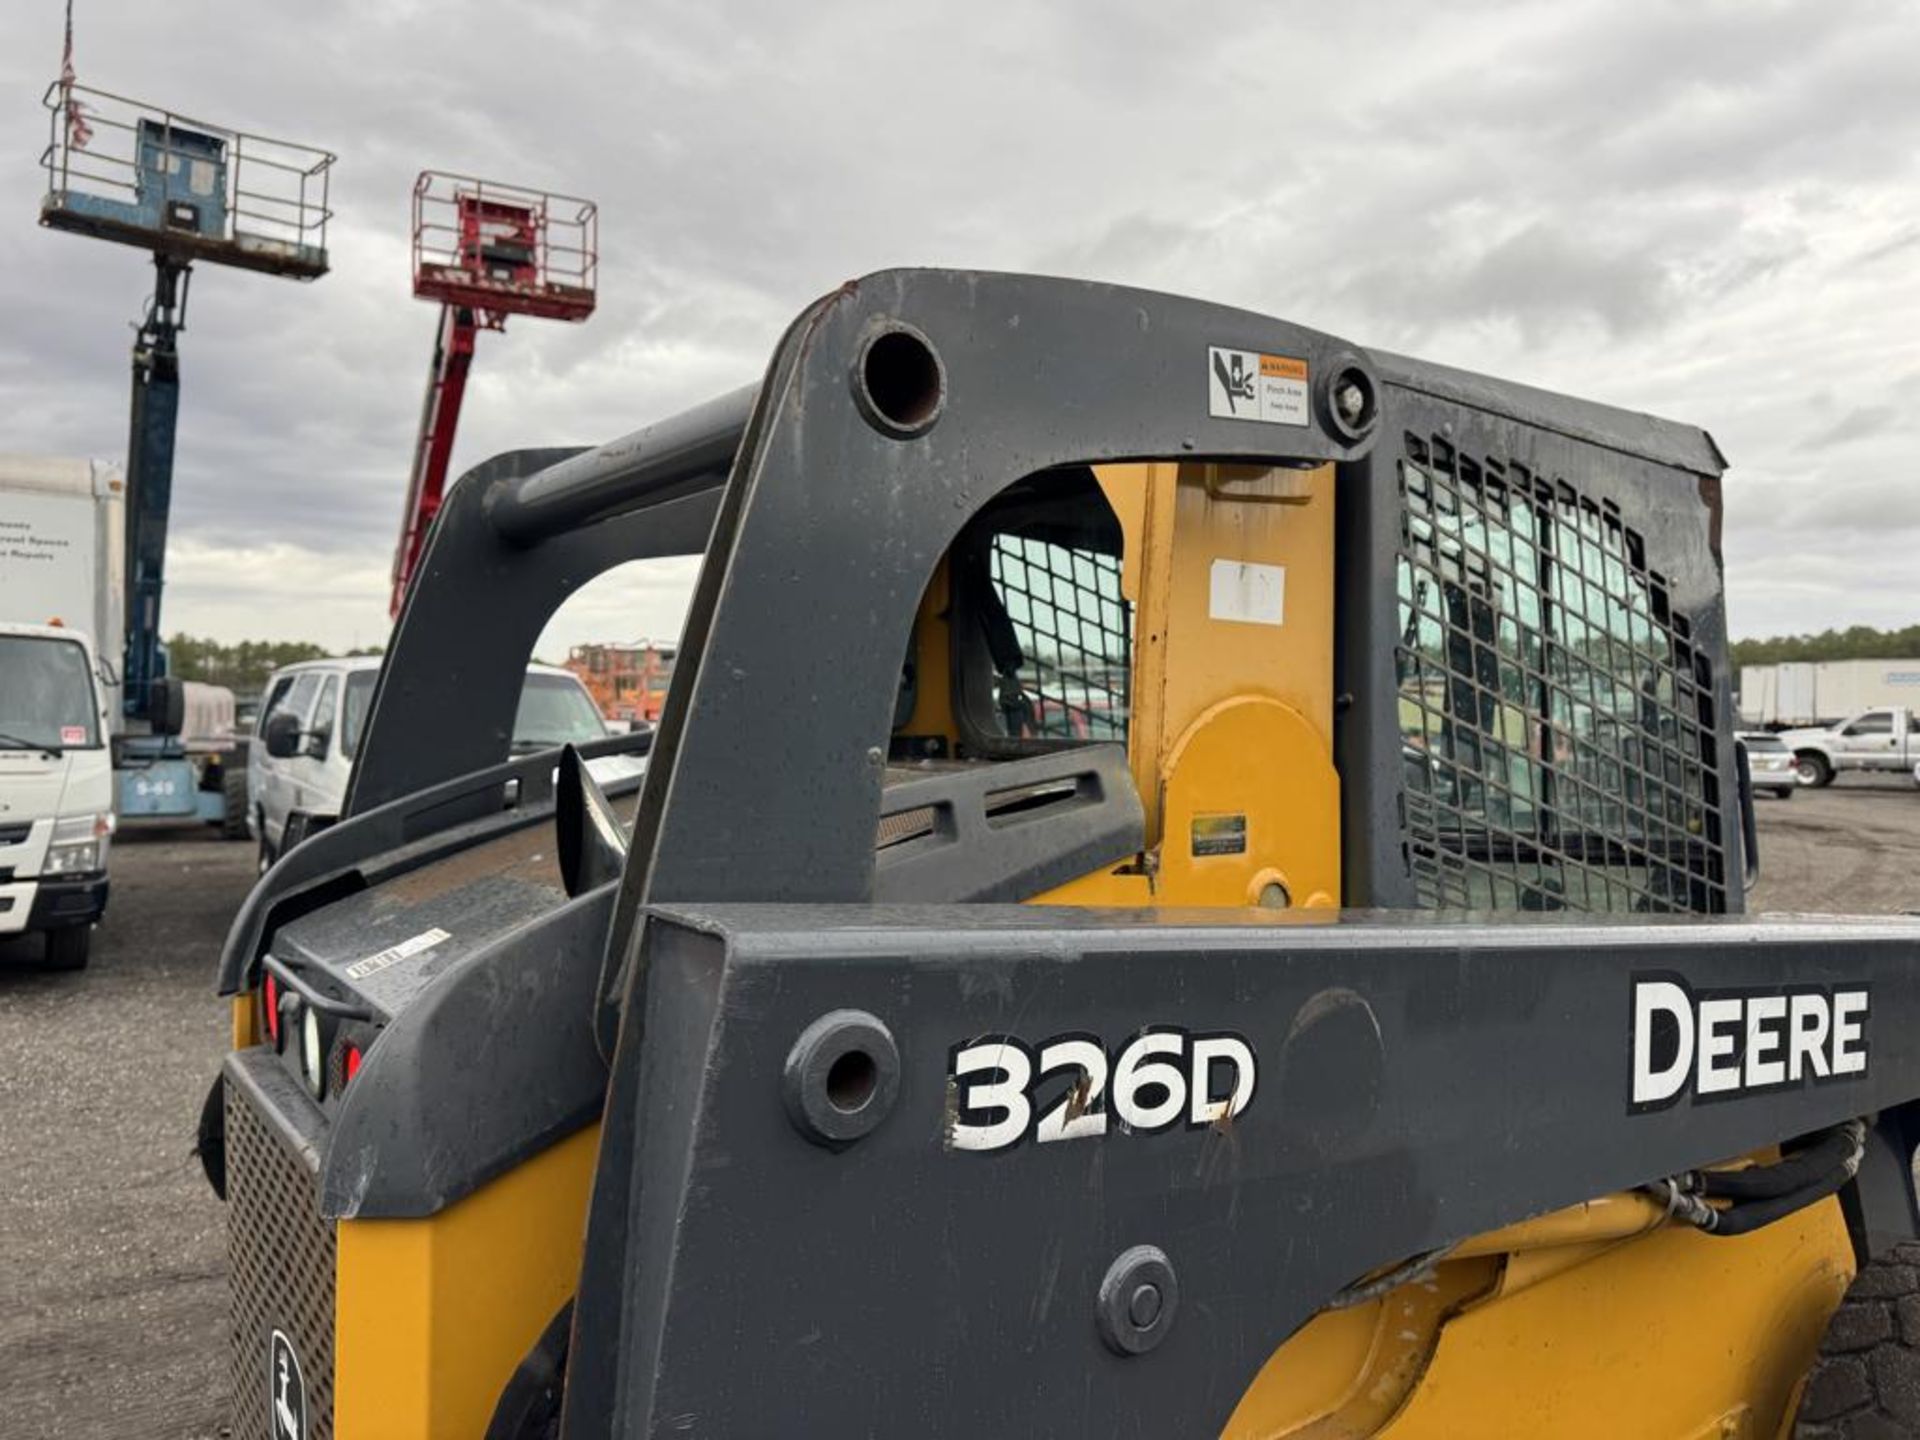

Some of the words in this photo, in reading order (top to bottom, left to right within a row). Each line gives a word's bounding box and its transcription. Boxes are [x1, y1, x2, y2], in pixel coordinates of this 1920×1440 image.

[11, 549, 54, 561] Repairs
[952, 1032, 1256, 1151] 326D
[1633, 980, 1869, 1104] DEERE
